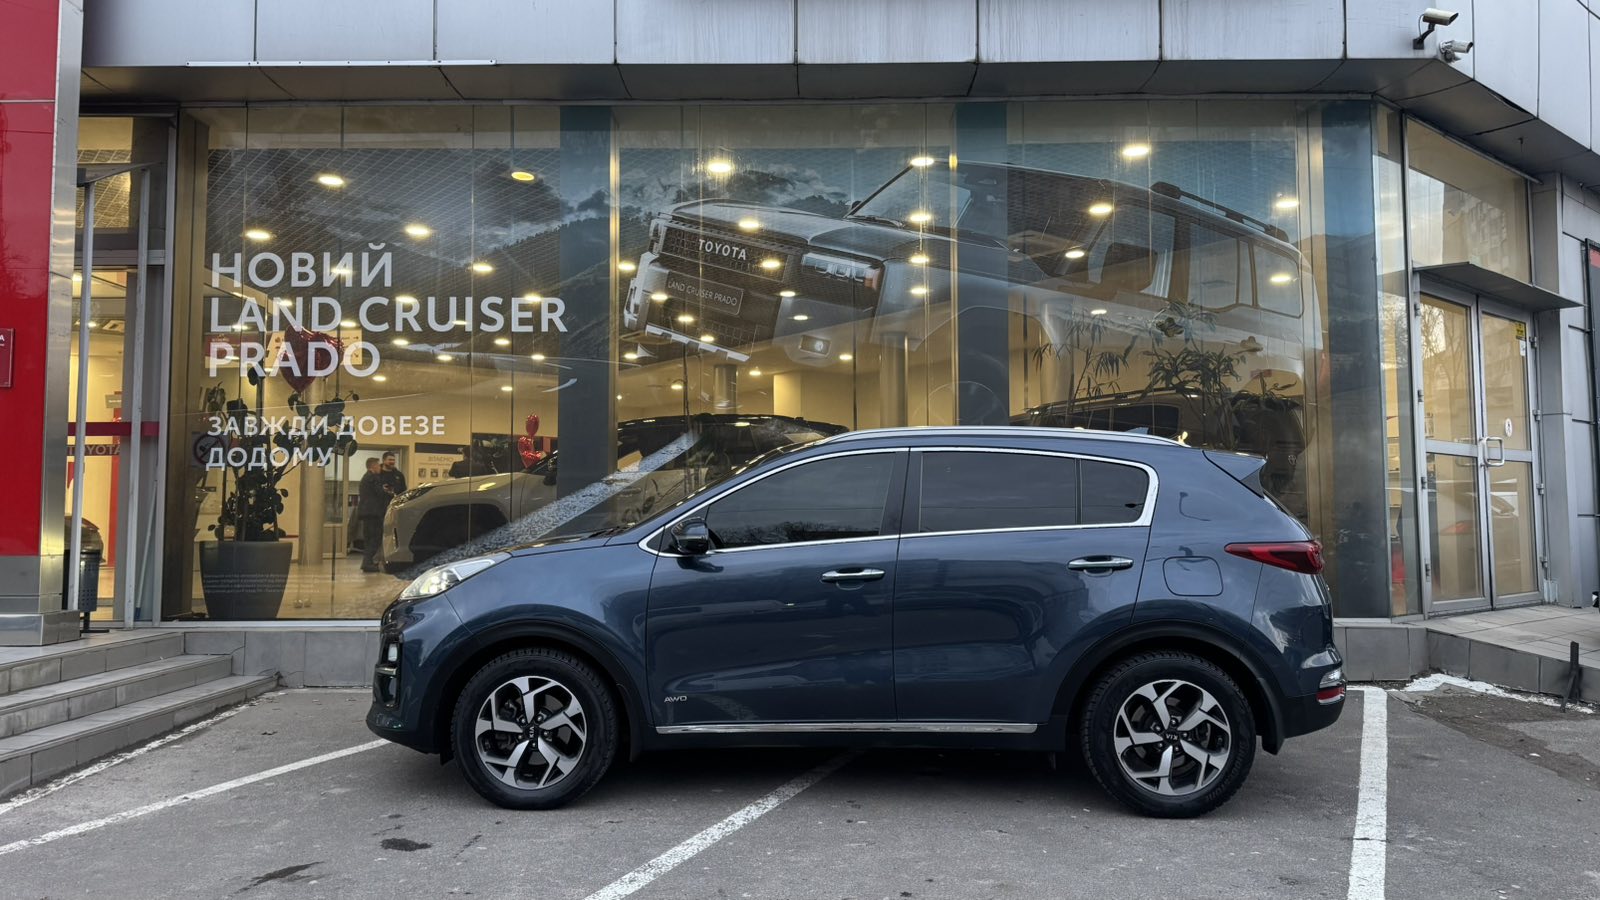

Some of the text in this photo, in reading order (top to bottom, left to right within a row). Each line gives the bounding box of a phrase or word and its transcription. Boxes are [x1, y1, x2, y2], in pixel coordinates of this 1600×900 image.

[698, 239, 746, 260] TOYOTA
[211, 242, 392, 288] НОВИЙ
[667, 281, 738, 306] LAND CRUISER PRADO
[210, 296, 568, 332] LAND CRUISER
[209, 341, 381, 378] PRADO
[207, 415, 445, 439] ЗАВЖДИ ДОВЕЗЕ
[67, 444, 121, 455] TYOTA
[205, 447, 334, 471] ДОДОМУ
[663, 695, 688, 703] AWD
